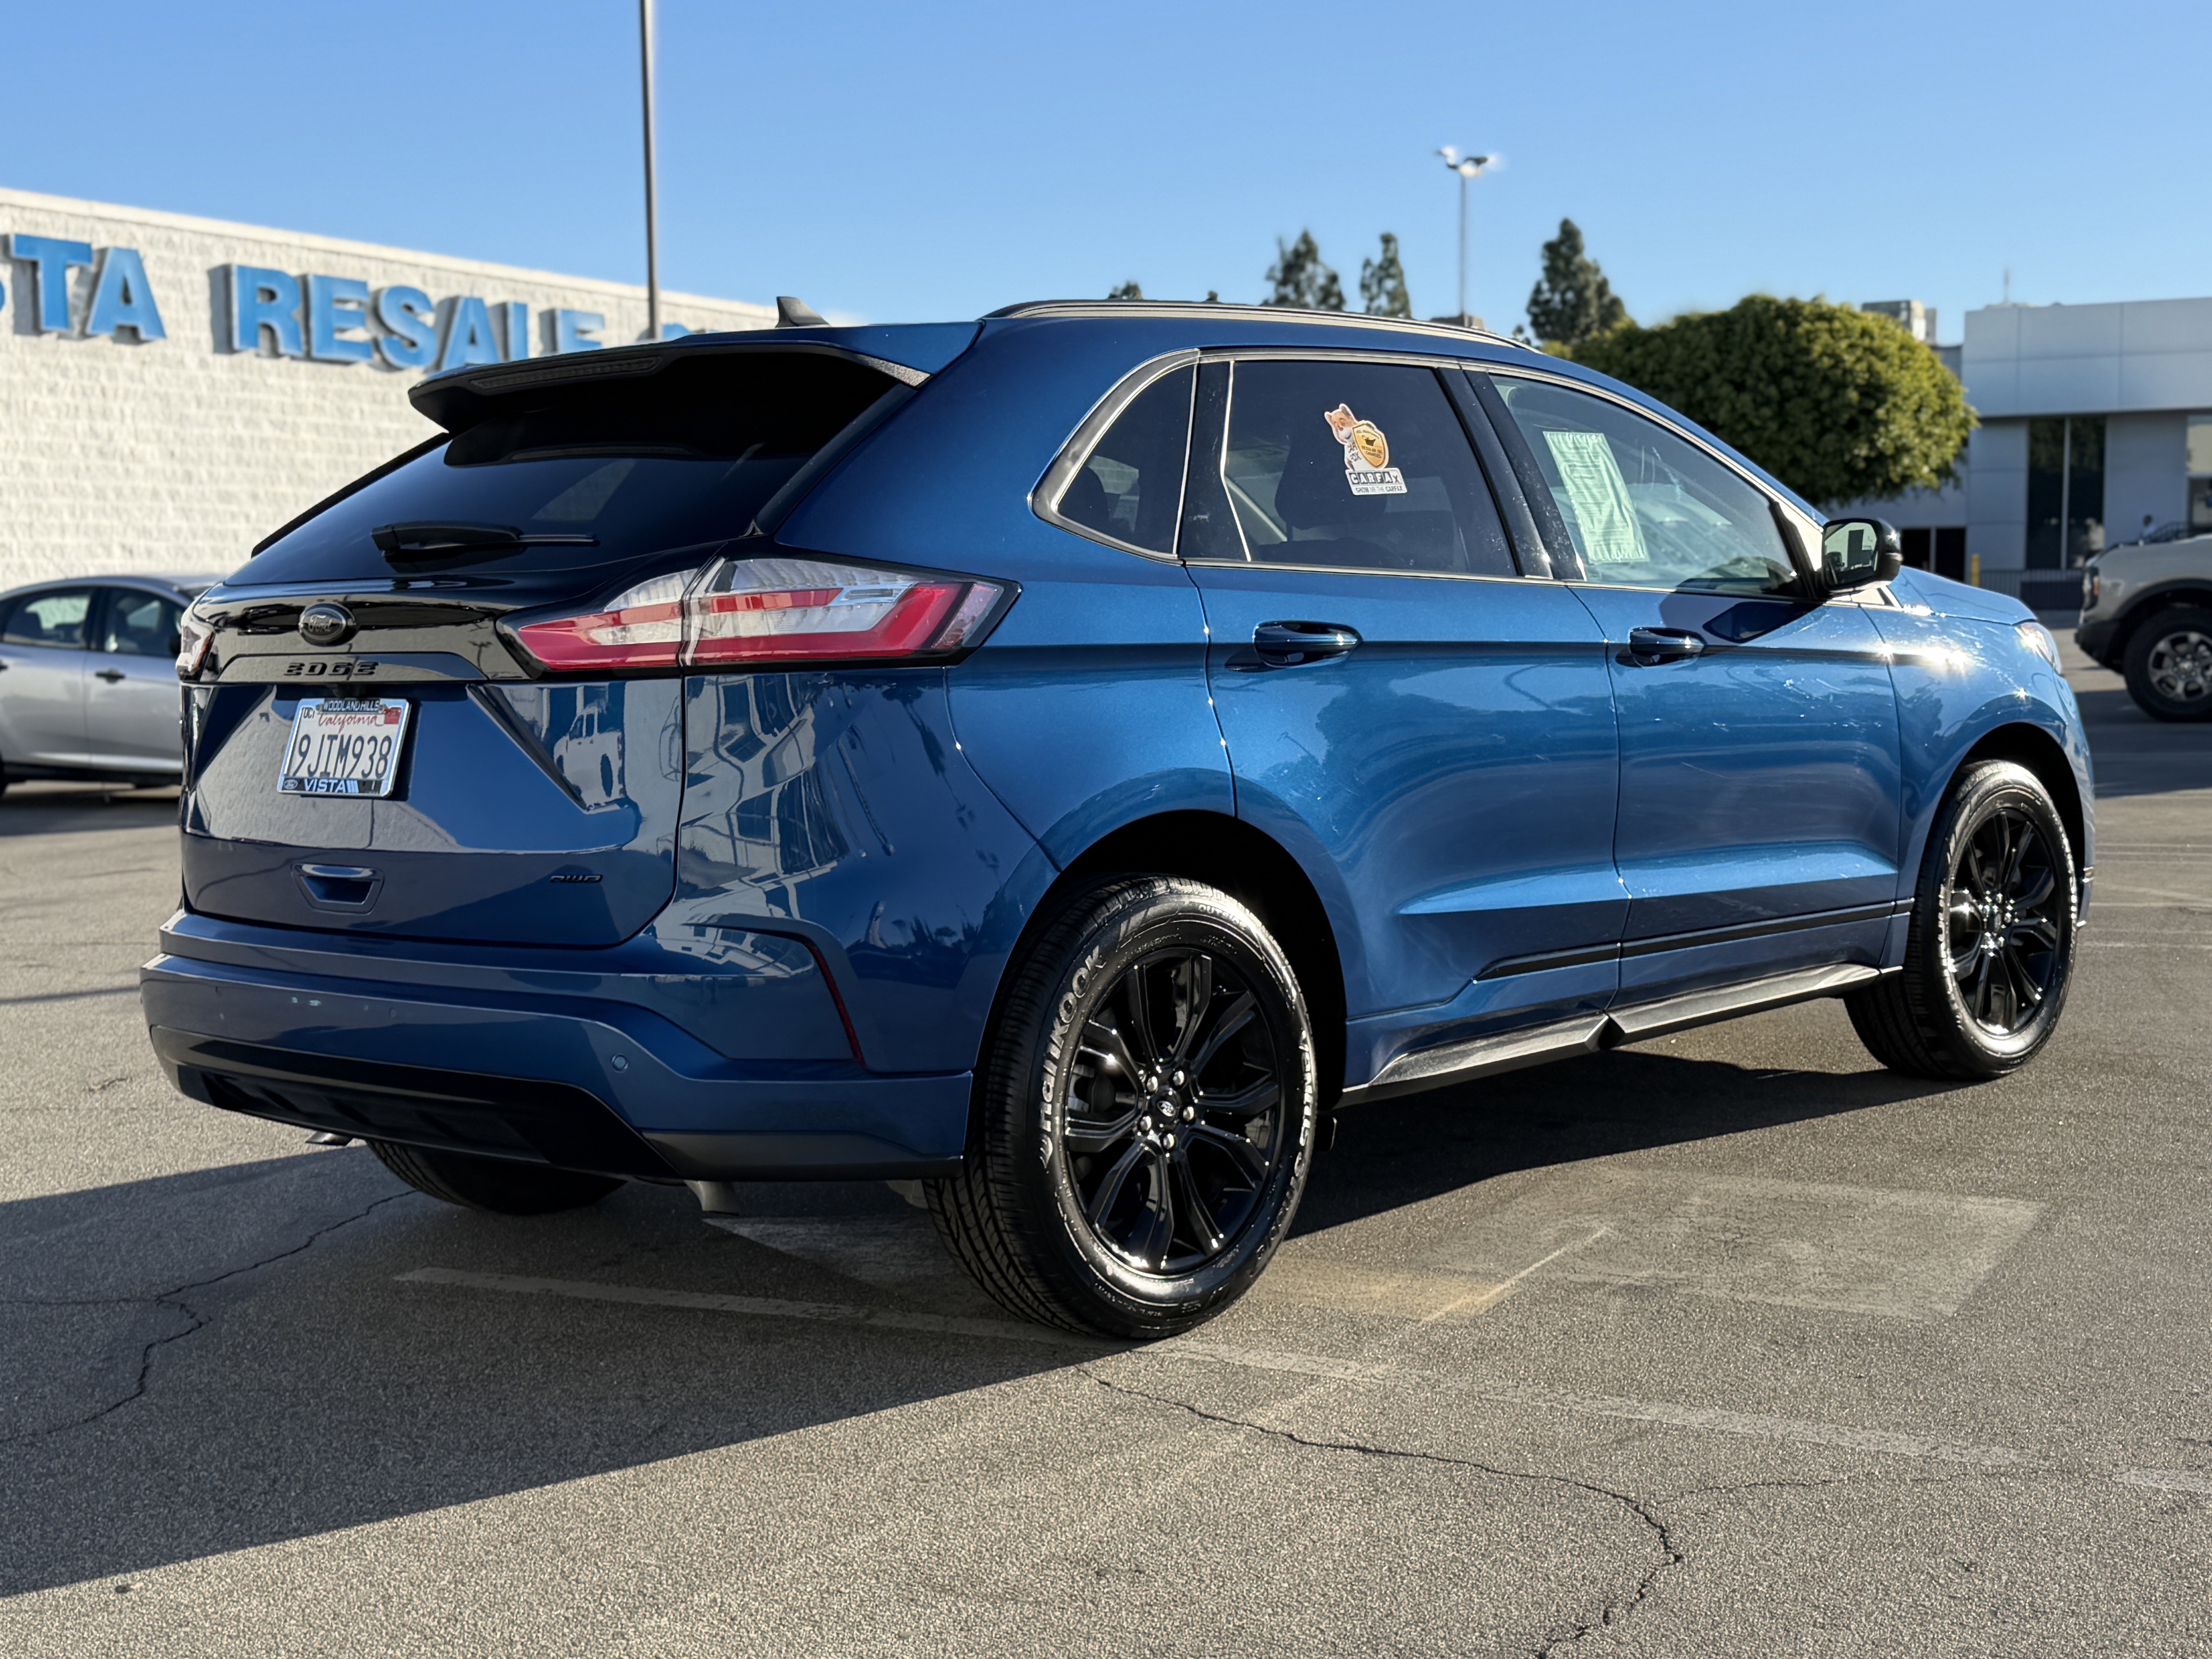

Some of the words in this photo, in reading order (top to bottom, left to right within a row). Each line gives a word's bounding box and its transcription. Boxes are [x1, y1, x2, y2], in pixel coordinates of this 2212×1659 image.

[0, 234, 167, 339] TA
[1350, 472, 1400, 484] CARFAX
[309, 614, 332, 632] Ford
[283, 662, 378, 676] EDGE
[323, 700, 361, 712] WOODLAND
[361, 701, 380, 712] HILLS
[318, 714, 384, 734] California
[304, 778, 346, 793] VISTA
